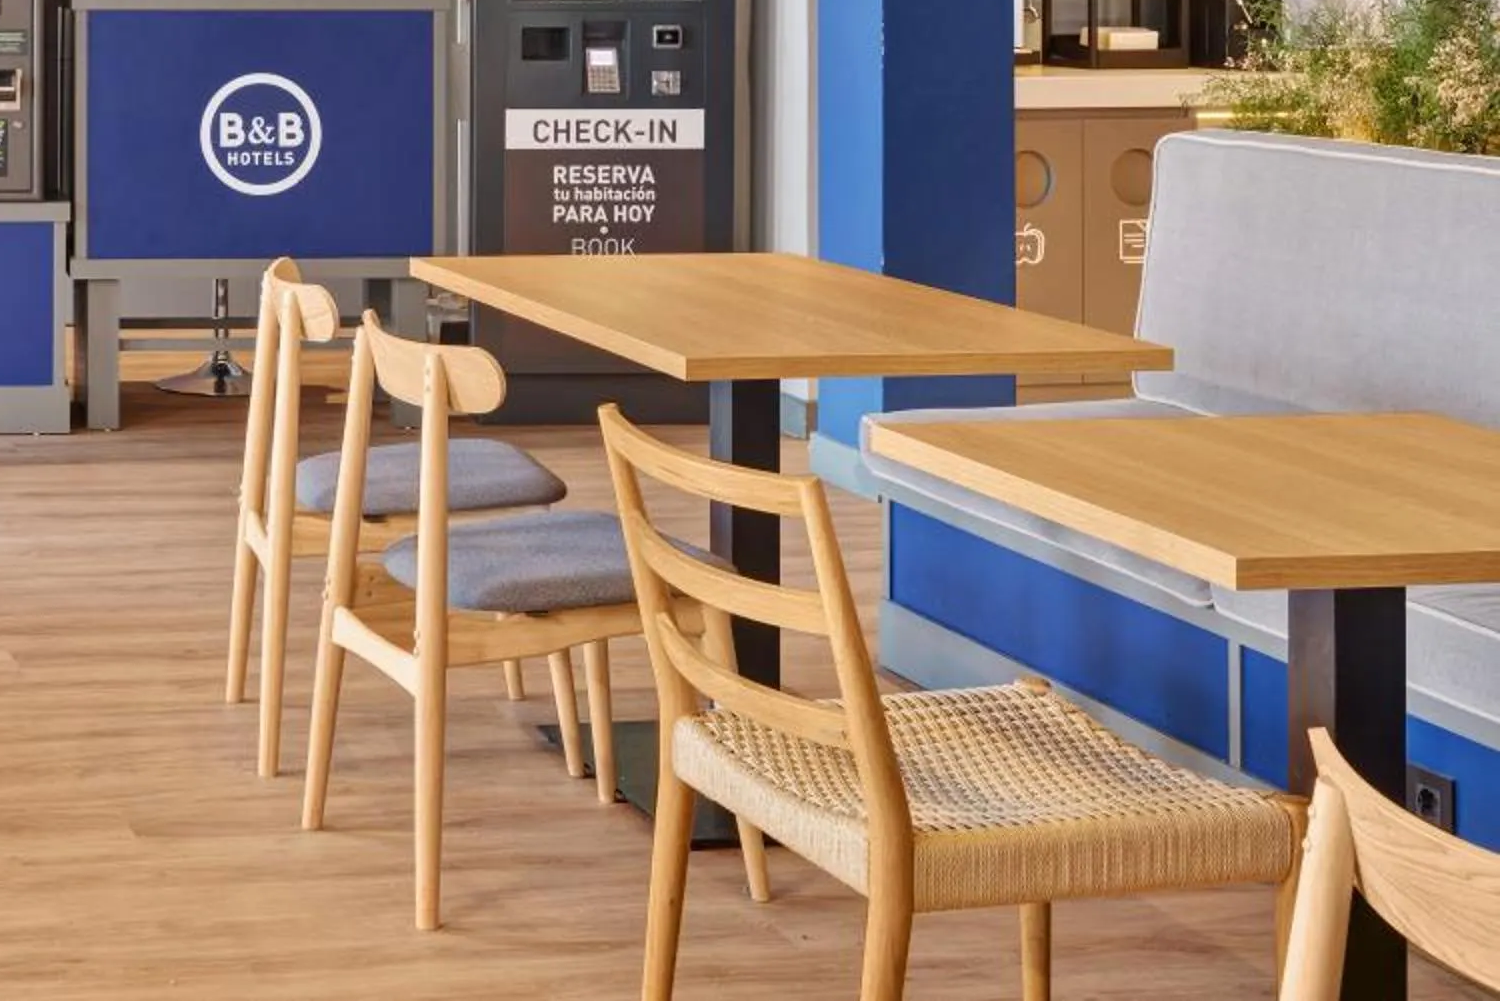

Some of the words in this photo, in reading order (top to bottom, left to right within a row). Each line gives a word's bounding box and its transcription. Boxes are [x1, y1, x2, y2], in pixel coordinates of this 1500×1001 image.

[219, 112, 305, 148] B&B
[533, 119, 678, 144] CHECK-IN
[226, 151, 296, 166] HOTELS
[553, 165, 656, 184] RESERVA
[553, 188, 570, 200] tu
[574, 186, 656, 200] habitación
[553, 205, 609, 223] PARA
[613, 205, 656, 223] HOY
[571, 238, 637, 256] BOOK
